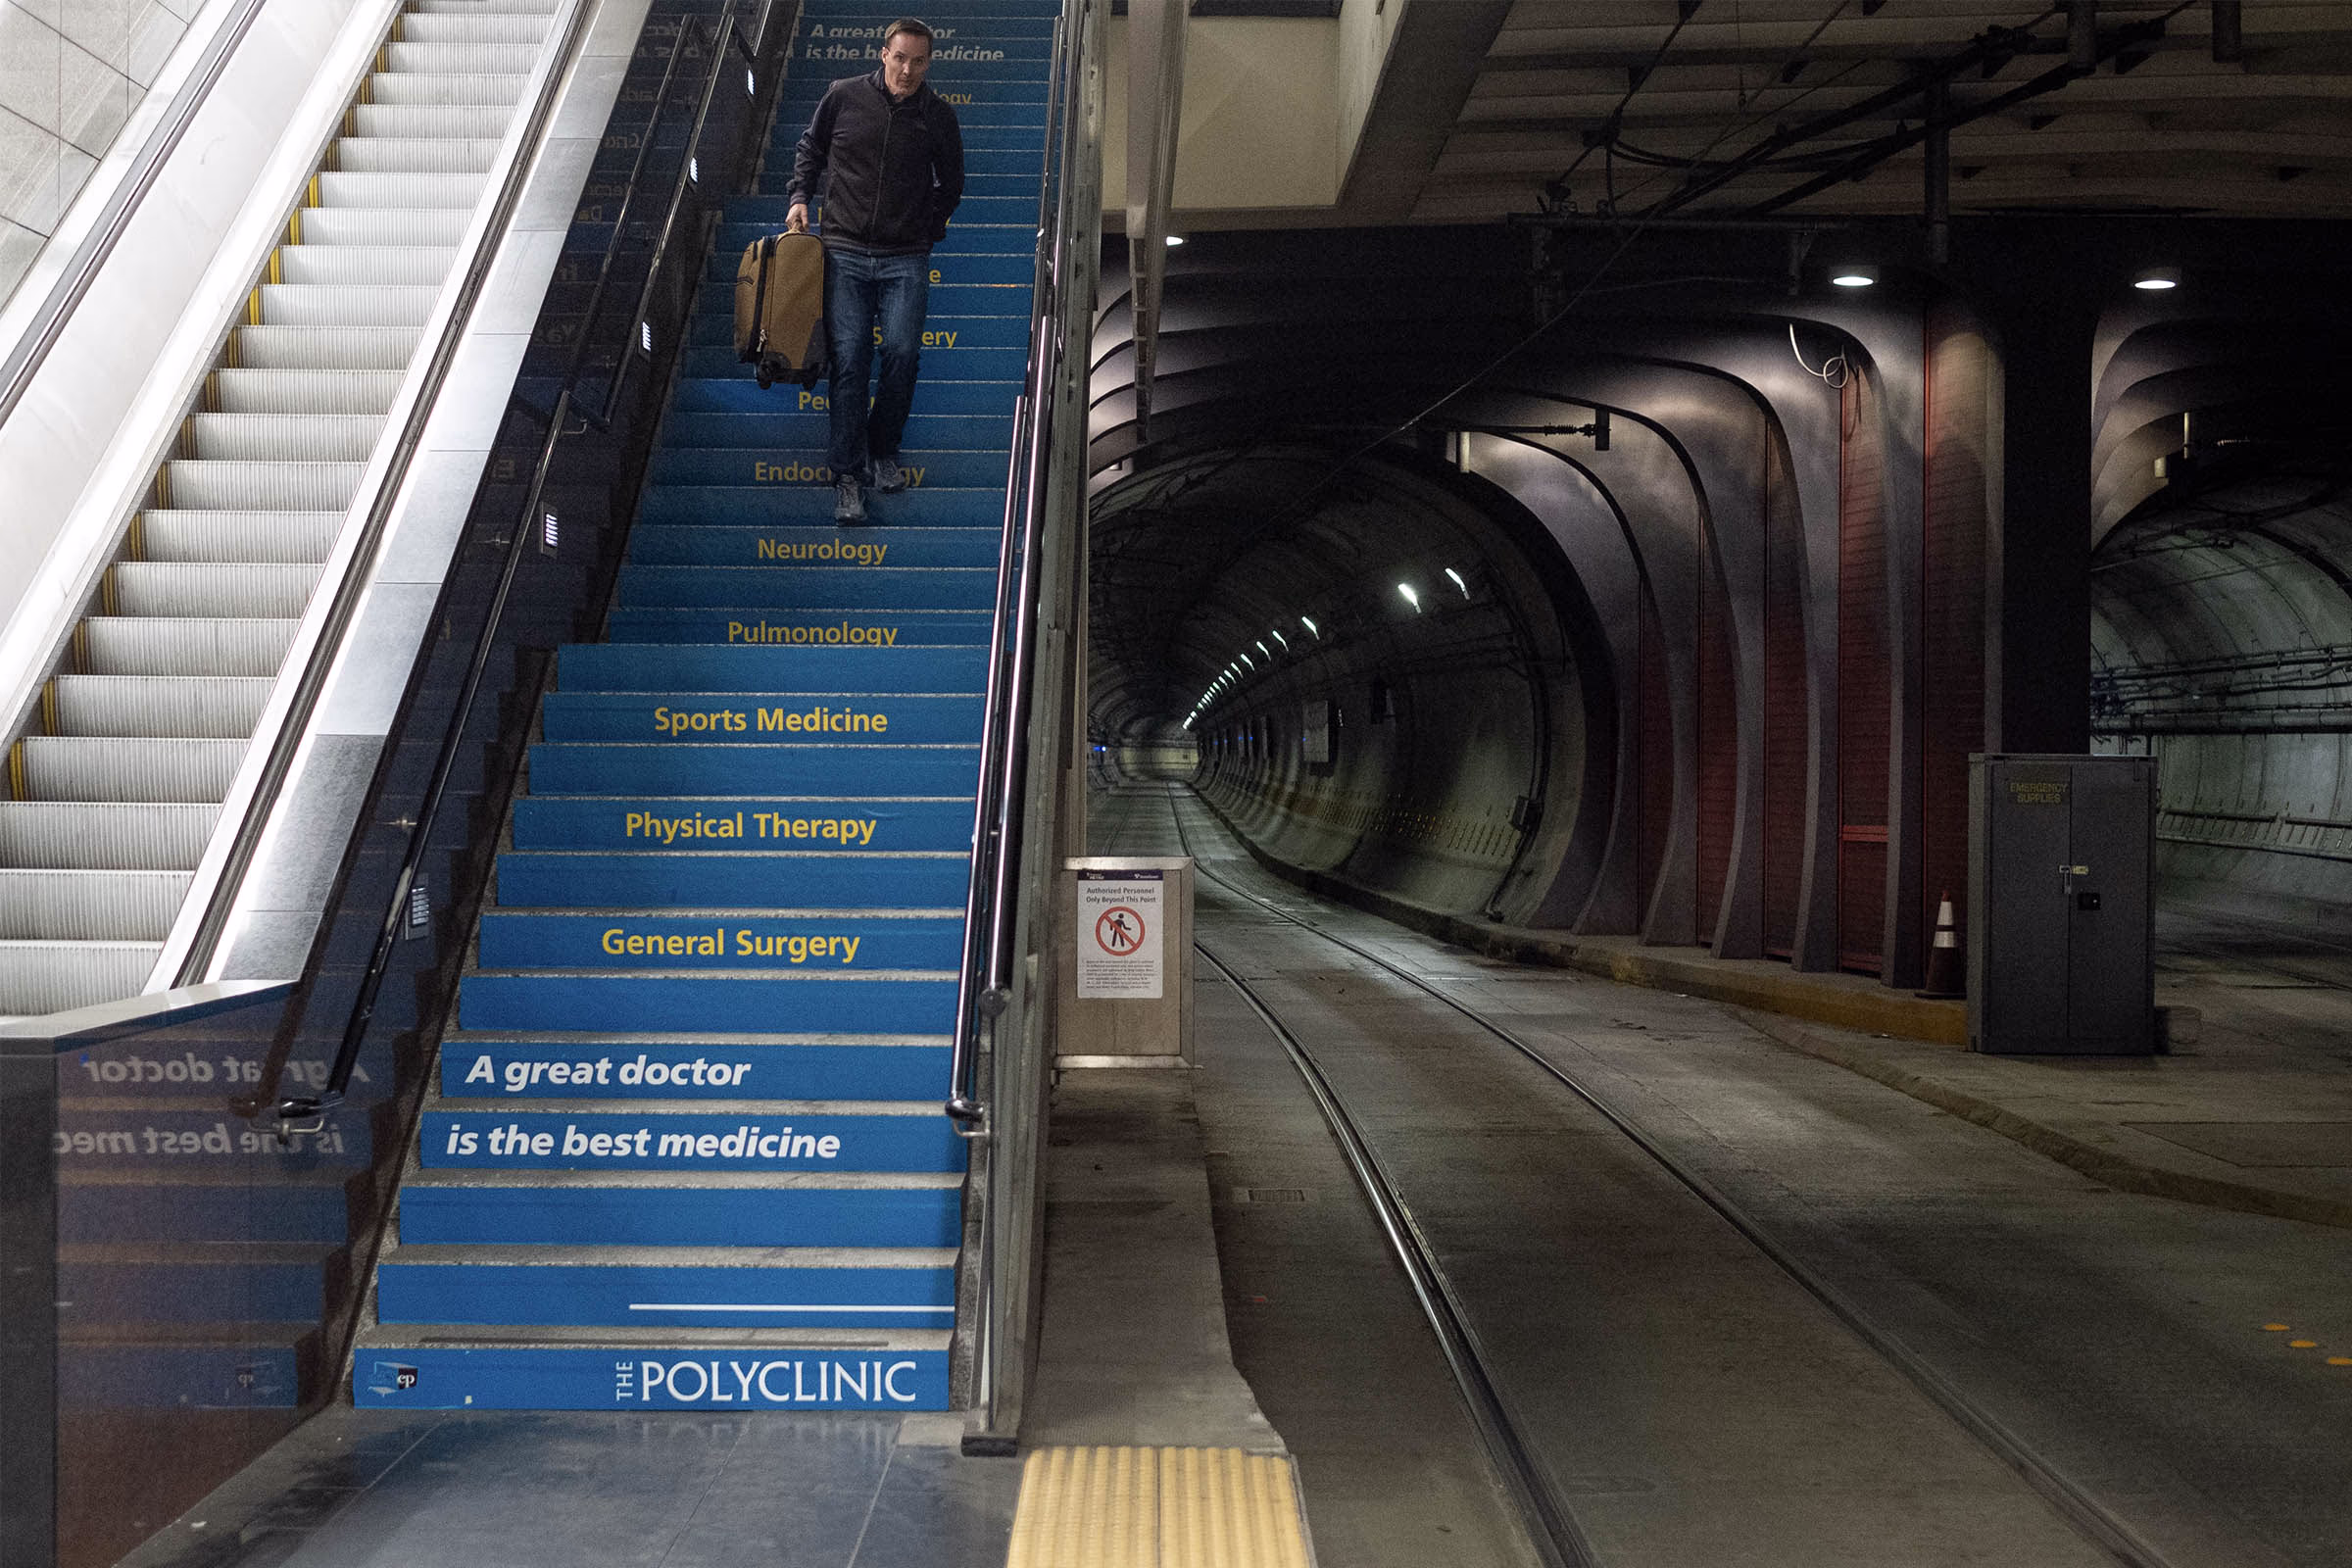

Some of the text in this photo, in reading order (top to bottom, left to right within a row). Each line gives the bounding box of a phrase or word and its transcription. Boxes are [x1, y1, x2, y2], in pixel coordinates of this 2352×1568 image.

[810, 24, 824, 38] A
[806, 44, 821, 60] is
[826, 44, 859, 60] the
[930, 45, 1004, 62] edicine
[758, 538, 888, 565] Neurology
[728, 620, 899, 647] Pulmonology
[655, 707, 888, 737] Sports Medicine
[626, 811, 877, 845] Physical Therapy
[602, 928, 860, 963] General Surgery
[465, 1054, 752, 1092] A great doctor
[446, 1124, 841, 1158] is the best medicine
[615, 1360, 916, 1402] THE POLYCLINIC
